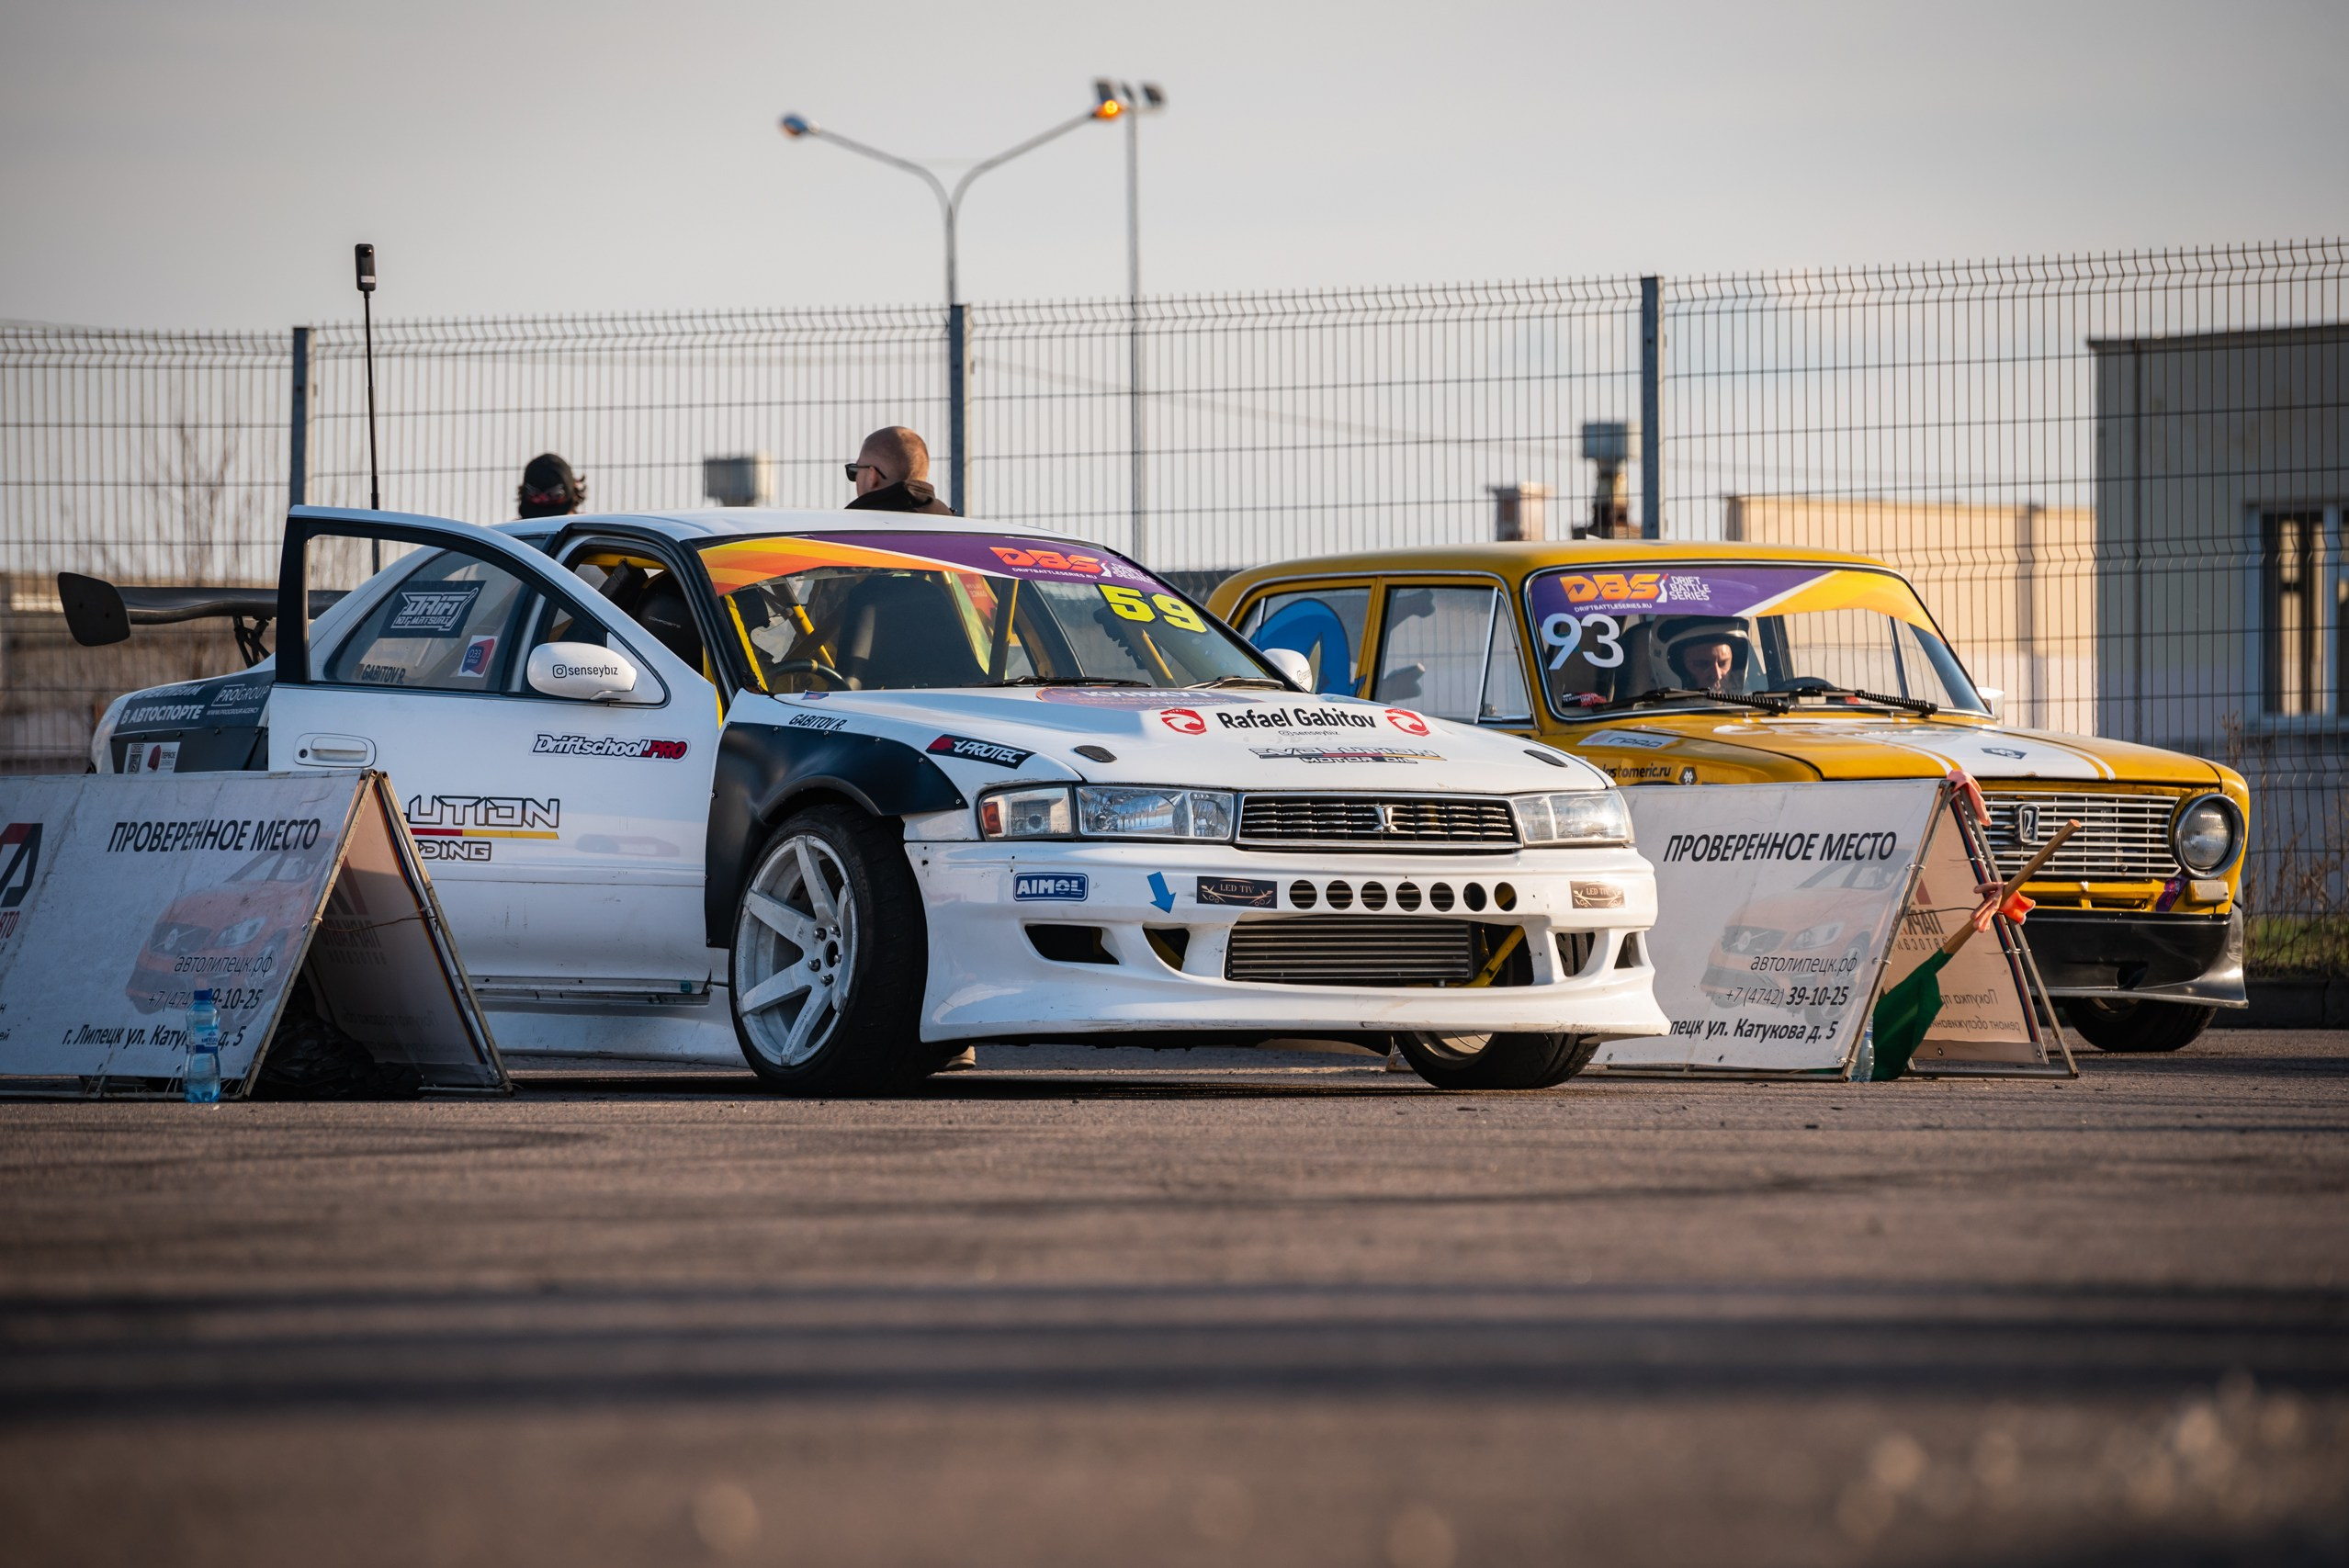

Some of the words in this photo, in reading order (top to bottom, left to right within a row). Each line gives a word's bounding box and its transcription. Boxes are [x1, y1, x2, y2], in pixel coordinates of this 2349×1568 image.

[989, 547, 1102, 573] DBS
[1011, 567, 1098, 580] DRIFTBATTLESERIES.RU
[1671, 576, 1700, 585] DRIFT
[1560, 573, 1661, 603] DBS
[1669, 583, 1711, 593] BATTLE
[1669, 592, 1711, 601] SERIES
[1095, 583, 1209, 634] 59
[1574, 603, 1652, 612] DRIFTBATTLESERIES.RU
[1542, 613, 1624, 670] 93
[468, 649, 482, 659] 033
[361, 663, 400, 683] GABITOV
[568, 664, 618, 678] senseybiz
[217, 684, 269, 702] PROGROUP
[120, 709, 130, 725] В
[130, 704, 205, 723] АВТОСПОРТЕ
[788, 714, 835, 729] GABITOV
[834, 718, 848, 731] R.
[1216, 707, 1293, 728] Rafael
[1293, 707, 1377, 728] Gabitov
[533, 734, 688, 760] Driftschool.PRO
[1248, 747, 1441, 759] EVOLUTION
[1301, 756, 1375, 764] MOTOR
[404, 795, 559, 829] UTION
[107, 819, 252, 852] ПРОВЕРЕННОЕ
[249, 818, 322, 852] МЕСТО
[1664, 832, 1820, 862] ПРОВЕРЕННОЕ
[1819, 831, 1897, 862] МЕСТО
[1220, 883, 1238, 893] LED
[1238, 885, 1255, 894] TIV
[1586, 887, 1598, 896] LED
[175, 952, 274, 976] автолипецк.рф
[1750, 952, 1858, 976] автолипецк.рф
[148, 990, 164, 1007] +7
[209, 988, 264, 1010] 9-10-25
[1726, 987, 1744, 1003] +7
[1743, 987, 1785, 1009] (4742)
[1786, 986, 1850, 1007] 39-10-25
[62, 1029, 72, 1045] г.
[73, 1024, 125, 1049] Липецк
[123, 1028, 146, 1050] ул.
[218, 1031, 231, 1051] д.
[232, 1026, 247, 1046] 5
[1669, 1020, 1707, 1040] пецк
[1705, 1019, 1729, 1040] ул.
[1734, 1018, 1807, 1043] Катукова
[1805, 1023, 1822, 1043] д.
[1825, 1021, 1839, 1040] 5
